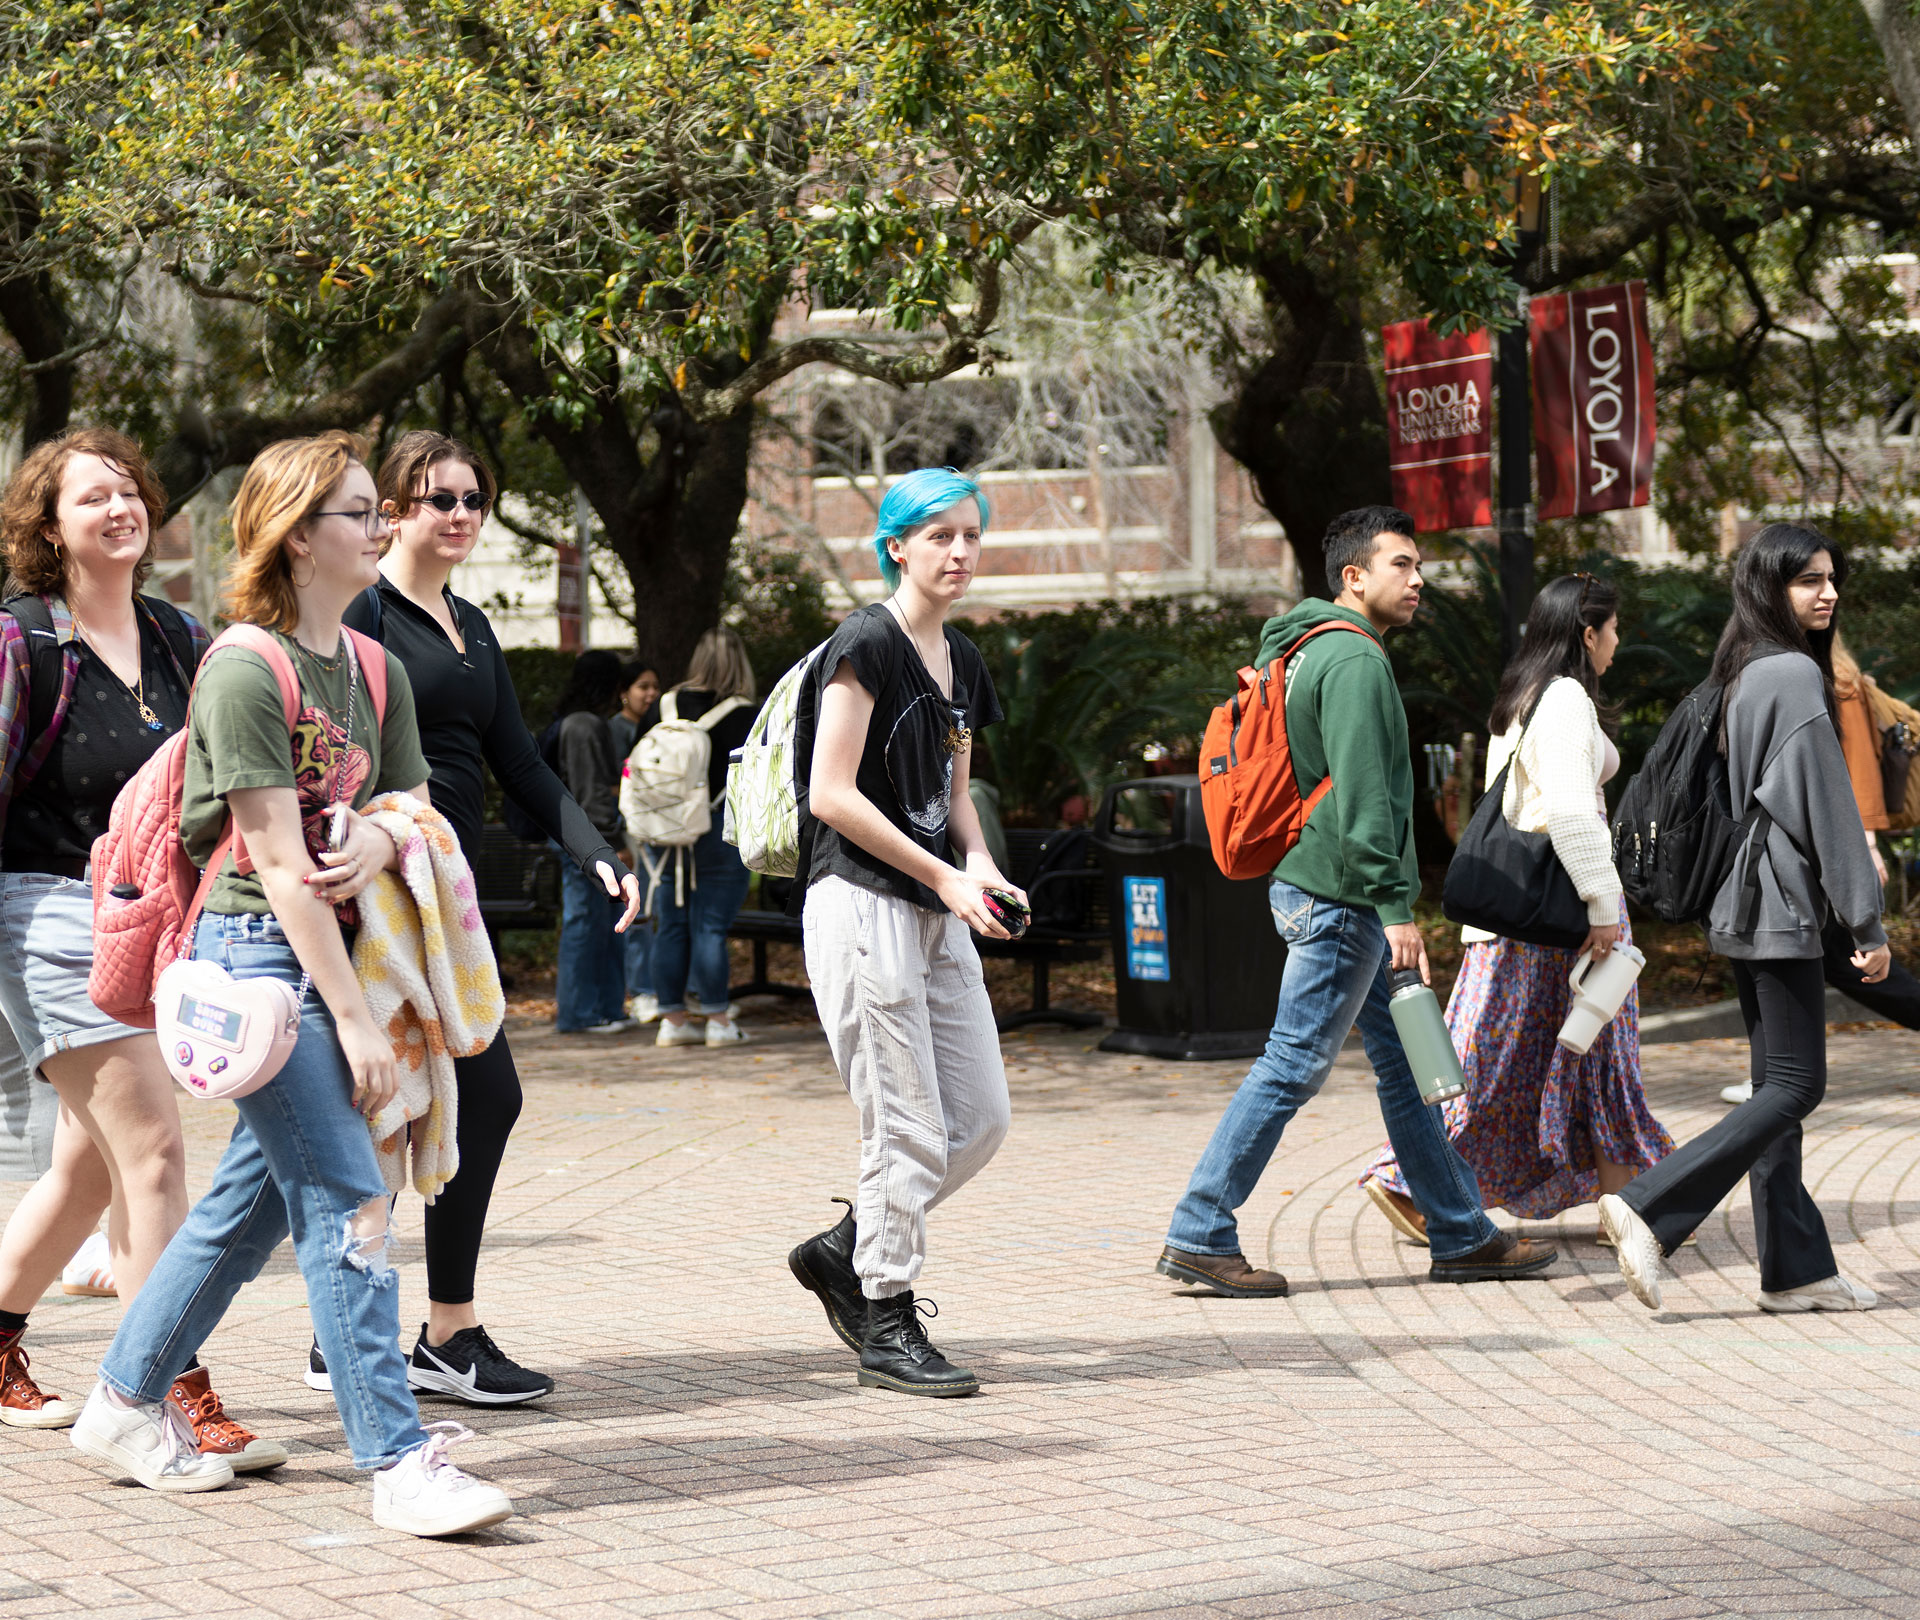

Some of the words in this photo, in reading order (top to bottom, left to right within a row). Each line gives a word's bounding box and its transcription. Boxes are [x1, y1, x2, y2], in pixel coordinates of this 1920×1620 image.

[1397, 380, 1480, 413] LOYOLA
[1585, 303, 1623, 496] LOYOLA
[1400, 403, 1481, 429] UNIVERSITY
[1400, 428, 1429, 444] NEW
[1430, 420, 1481, 439] ORLEANS
[192, 1015, 224, 1036] OVER
[194, 1002, 227, 1024] GAME
